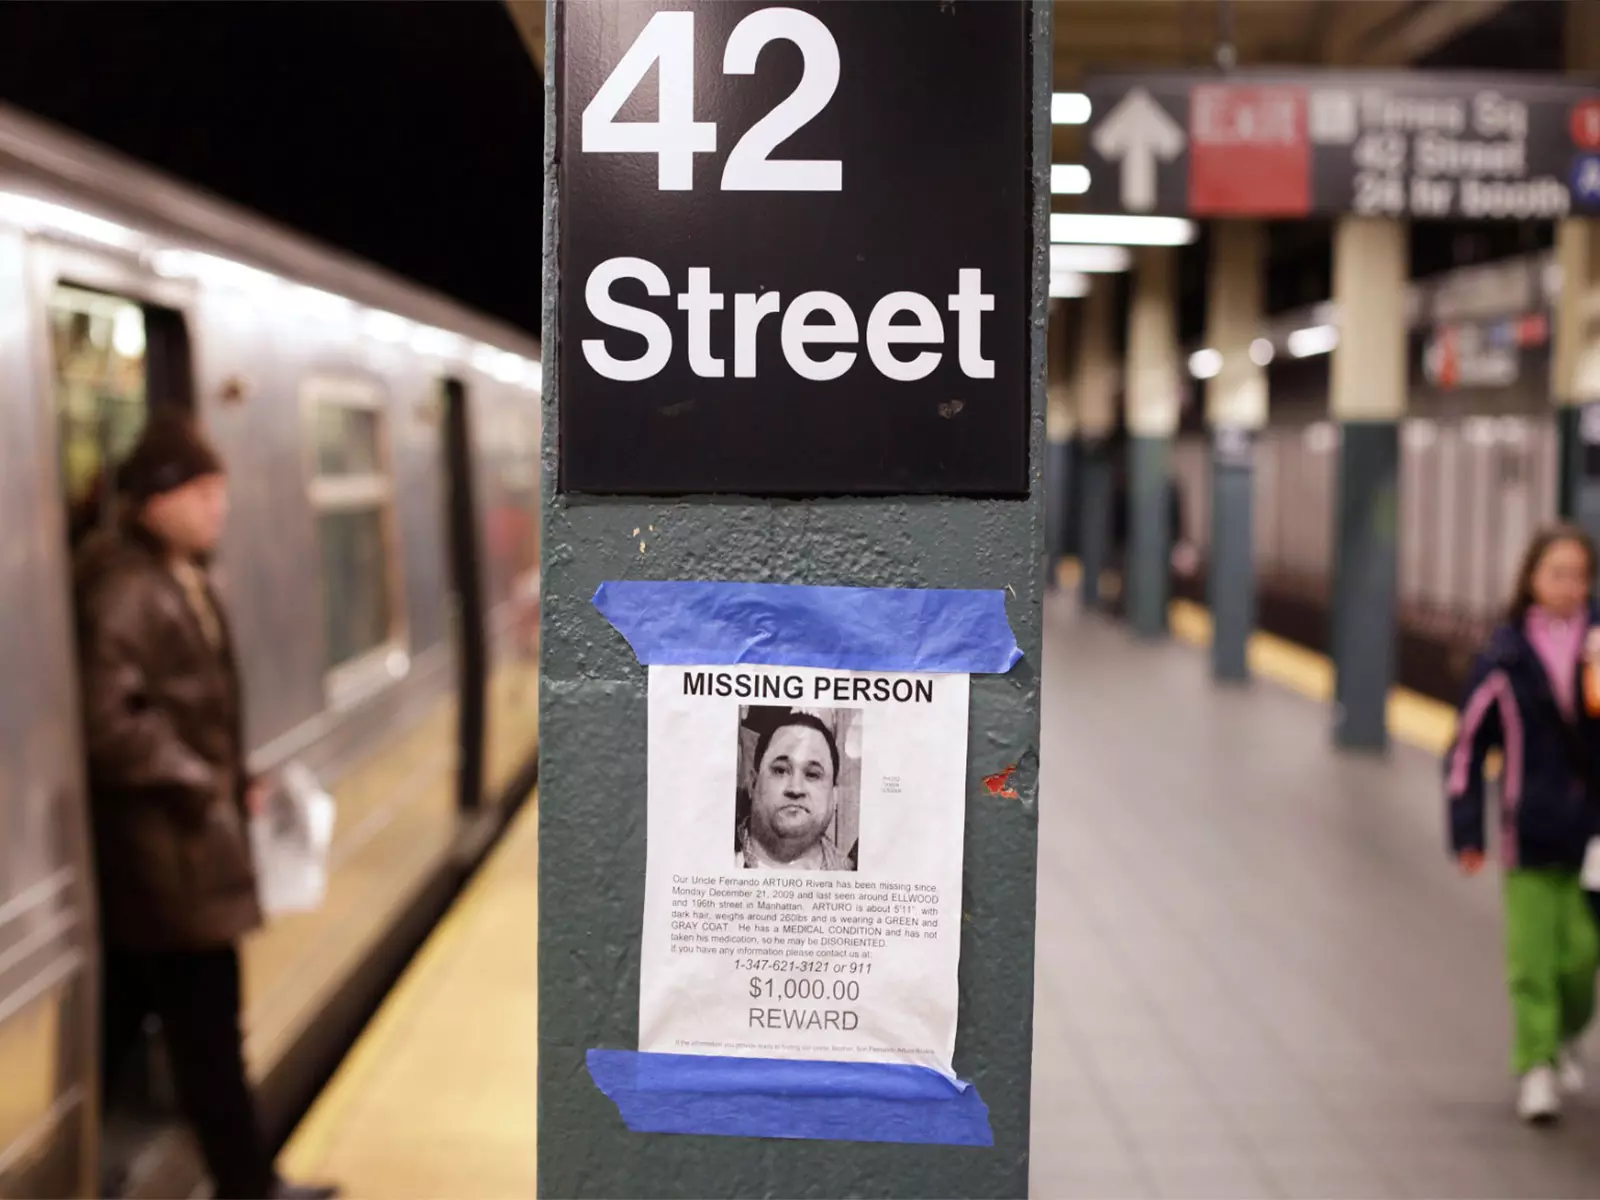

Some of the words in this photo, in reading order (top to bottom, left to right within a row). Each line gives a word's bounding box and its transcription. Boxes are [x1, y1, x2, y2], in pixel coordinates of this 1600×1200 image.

[582, 7, 842, 191] 42
[582, 257, 994, 381] Street
[683, 672, 803, 699] MISSING
[814, 676, 933, 703] PERSON
[672, 875, 688, 884] Our
[691, 876, 716, 885] Uncle
[719, 877, 760, 886] Fernando
[763, 878, 802, 887] ARTURO
[806, 879, 833, 888] Rivera
[836, 880, 851, 888] has
[855, 880, 876, 889] been
[879, 881, 911, 892] missing
[672, 887, 705, 897] Monday
[709, 888, 753, 897] December
[773, 890, 794, 899] 2009
[798, 891, 813, 899] and
[816, 892, 831, 900] last
[859, 893, 888, 901] around
[892, 893, 939, 904] ELLWOOD
[672, 899, 687, 907] and
[693, 899, 715, 908] 196th
[719, 901, 743, 909] street
[812, 902, 852, 911] ARTURO
[856, 904, 863, 912] is
[866, 904, 890, 913] about
[921, 907, 939, 916] with
[671, 910, 690, 918] dark
[715, 913, 744, 922] weighs
[747, 913, 777, 921] around
[811, 914, 827, 923] and
[830, 915, 837, 923] is
[840, 915, 873, 926] wearing
[885, 916, 919, 926] GREEN
[922, 918, 938, 927] and
[671, 921, 697, 930] GRAY
[739, 923, 751, 931] He
[755, 924, 770, 932] has
[783, 924, 824, 935] MEDICAL
[828, 926, 882, 936] CONDITION
[885, 928, 901, 937] and
[905, 929, 920, 938] has
[924, 931, 937, 939] not
[671, 933, 694, 941] taken
[696, 934, 709, 942] his
[787, 938, 805, 947] may
[807, 937, 818, 945] be
[696, 946, 717, 954] have
[719, 948, 734, 956] any
[737, 947, 784, 956] information
[786, 948, 814, 957] please
[734, 959, 829, 972] 1-347-621-3121
[833, 964, 847, 973] or
[849, 962, 872, 974] 911
[749, 976, 860, 1001] $1,000.00
[749, 1008, 859, 1031] REWARD
